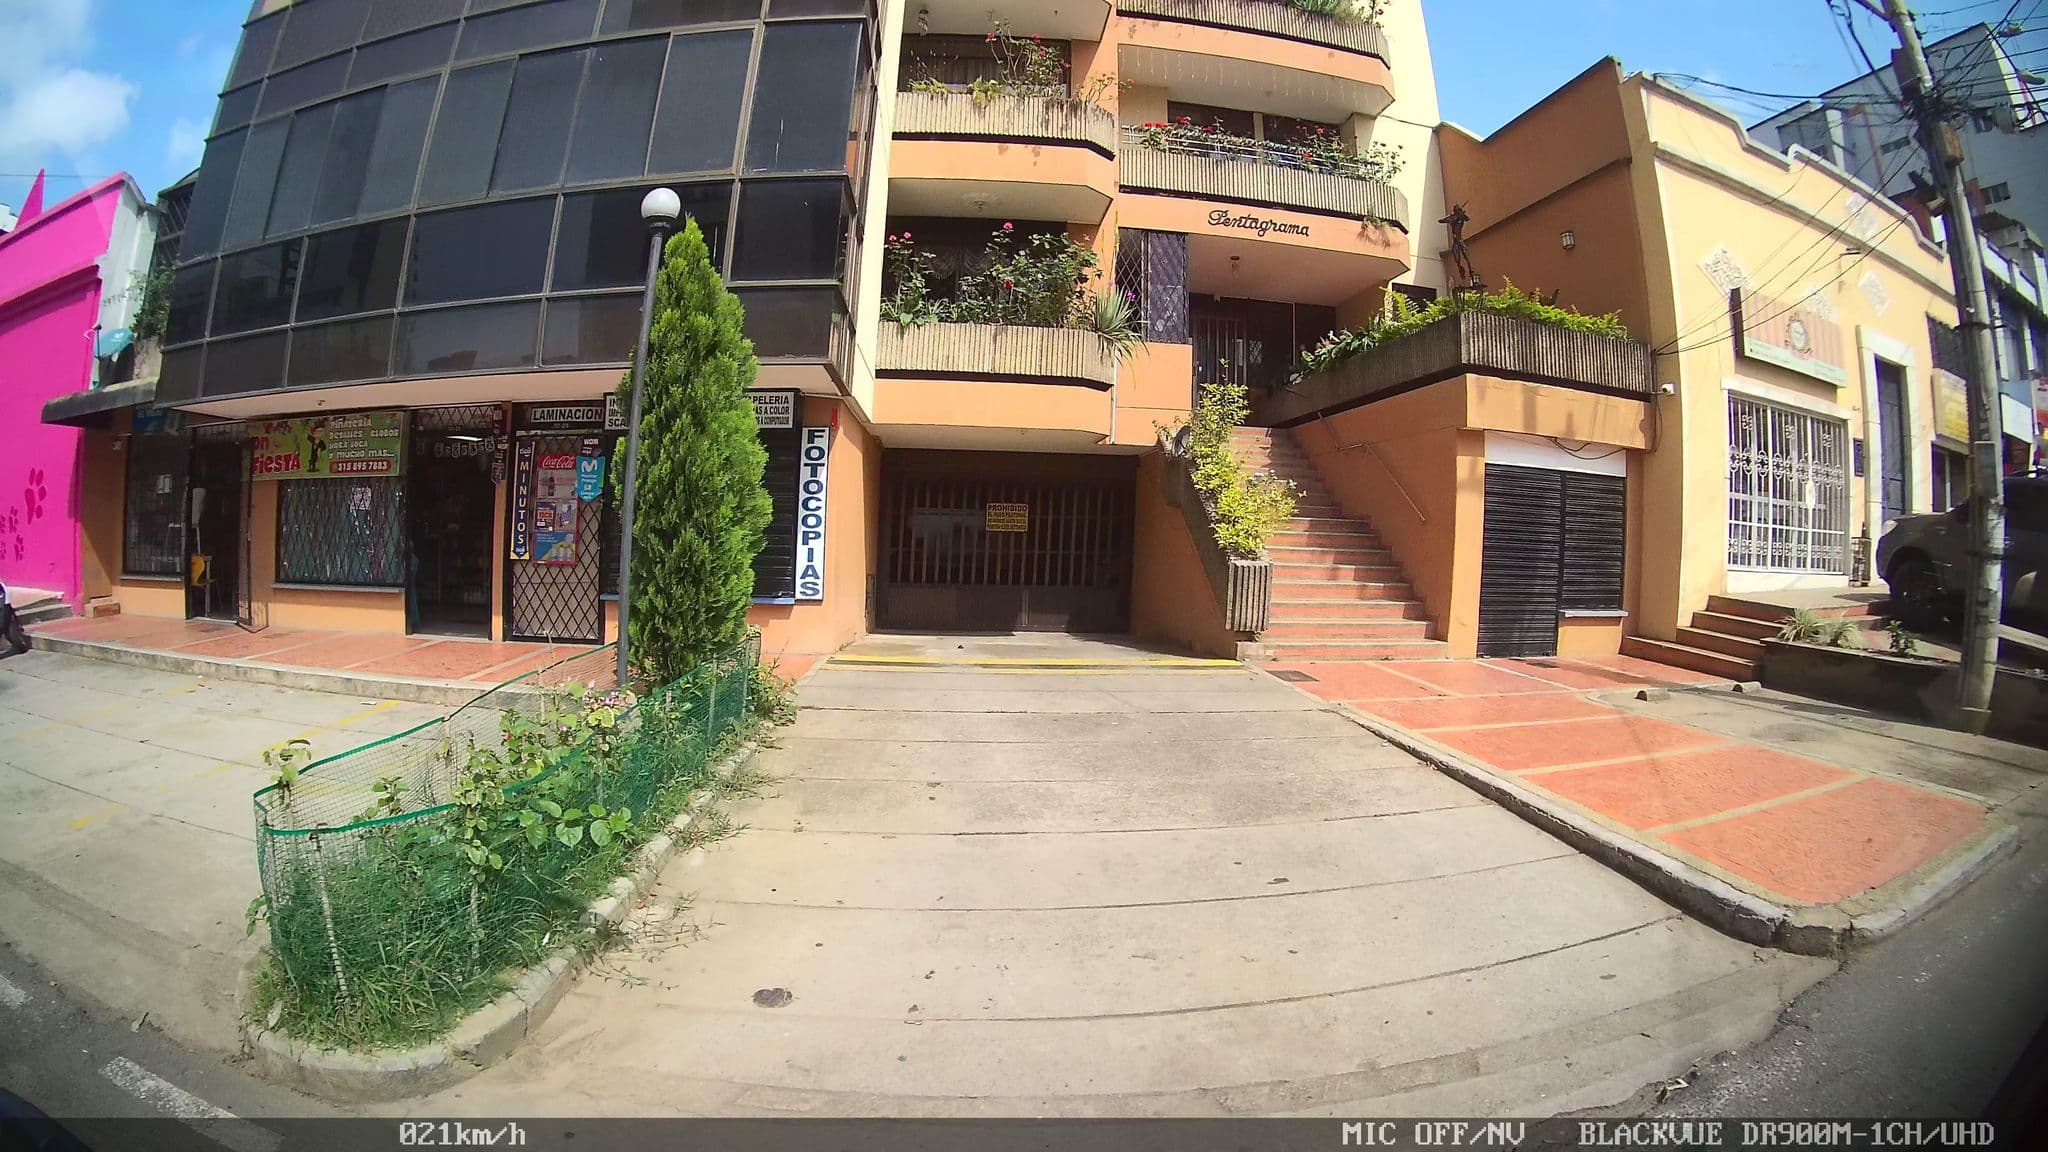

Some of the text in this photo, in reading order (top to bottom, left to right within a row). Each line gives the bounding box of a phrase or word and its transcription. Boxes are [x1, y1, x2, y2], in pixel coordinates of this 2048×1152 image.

[1208, 209, 1310, 237] Pentagrama
[533, 408, 602, 420] LAMINACION
[770, 406, 790, 415] COLOR
[337, 462, 351, 470] 315
[517, 461, 530, 544] MINUTOS
[988, 504, 1028, 512] PROHIBIDO
[799, 428, 826, 597] FOTOCOPIAS
